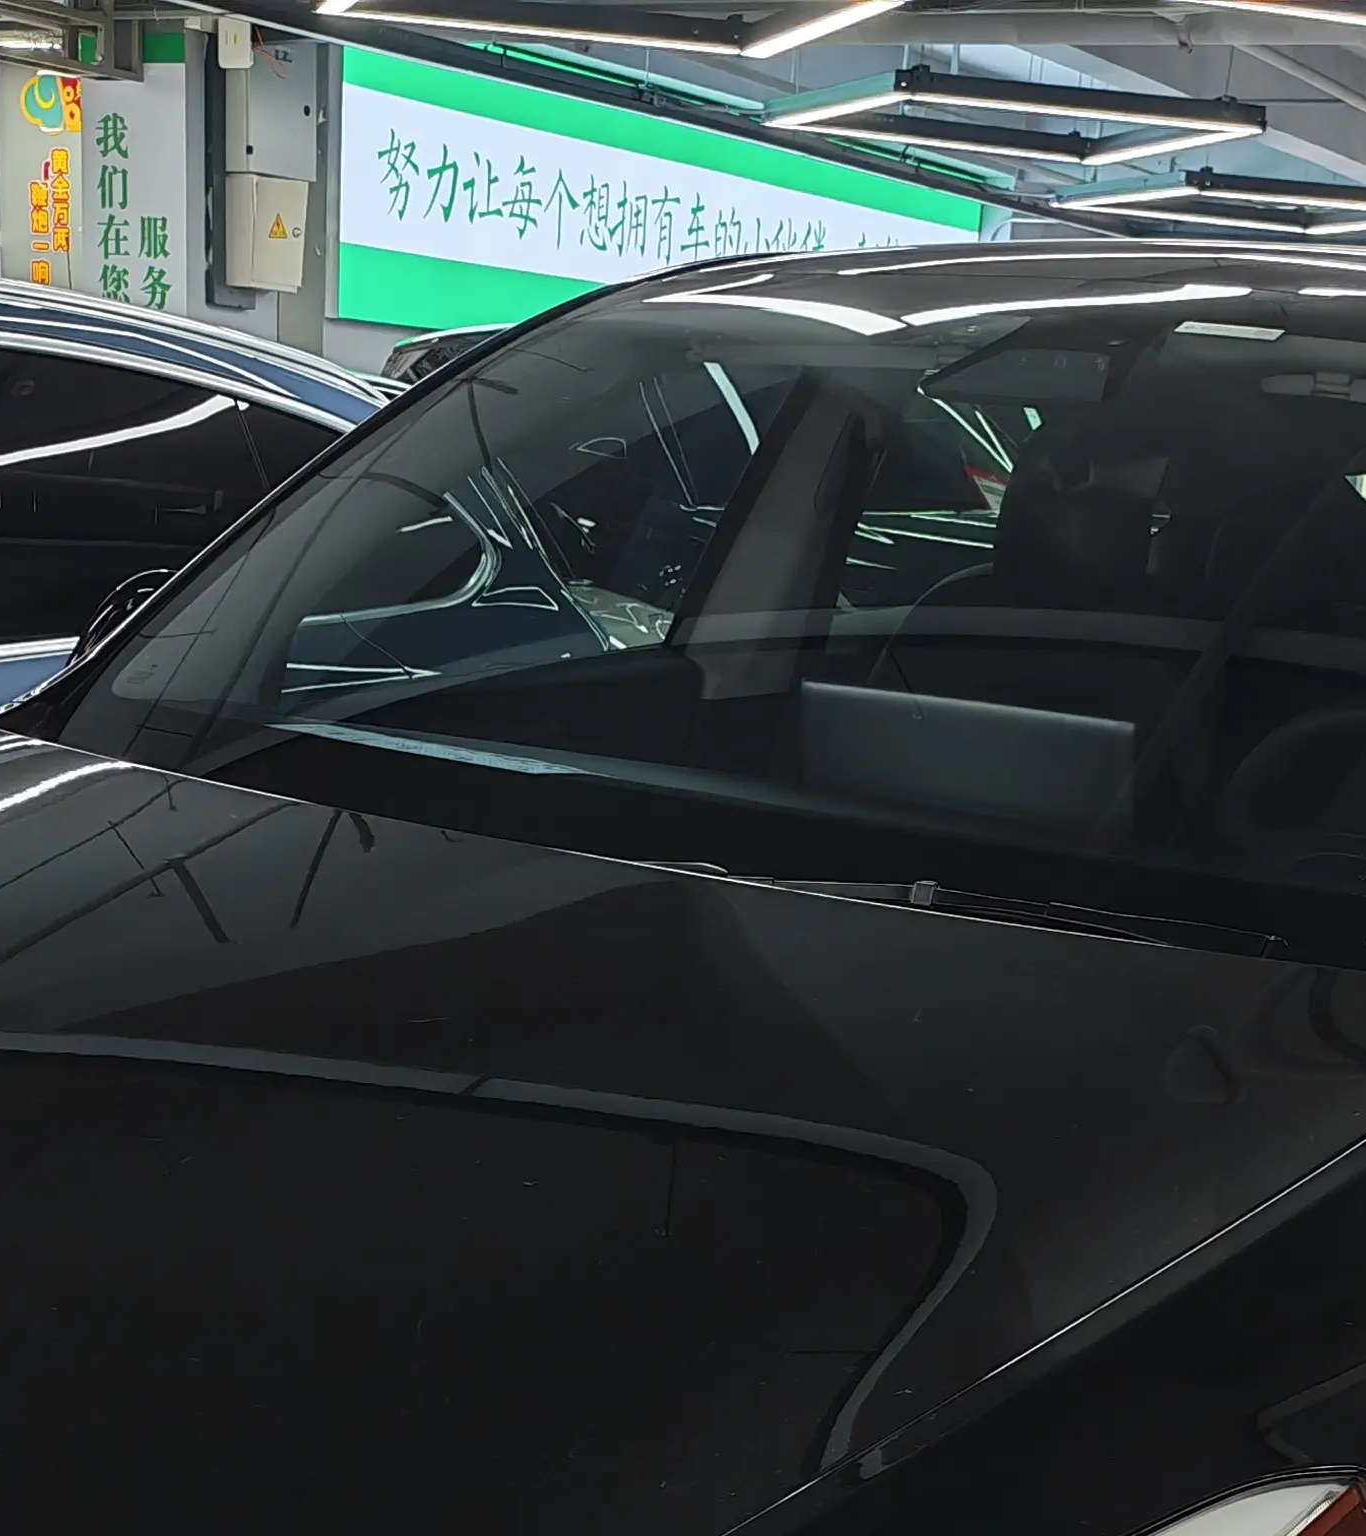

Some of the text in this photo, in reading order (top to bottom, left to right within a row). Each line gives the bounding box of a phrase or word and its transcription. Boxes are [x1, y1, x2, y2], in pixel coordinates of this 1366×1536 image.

[50, 148, 71, 252] 黄金万两
[95, 113, 131, 304] 我们在您
[138, 215, 173, 310] 服务
